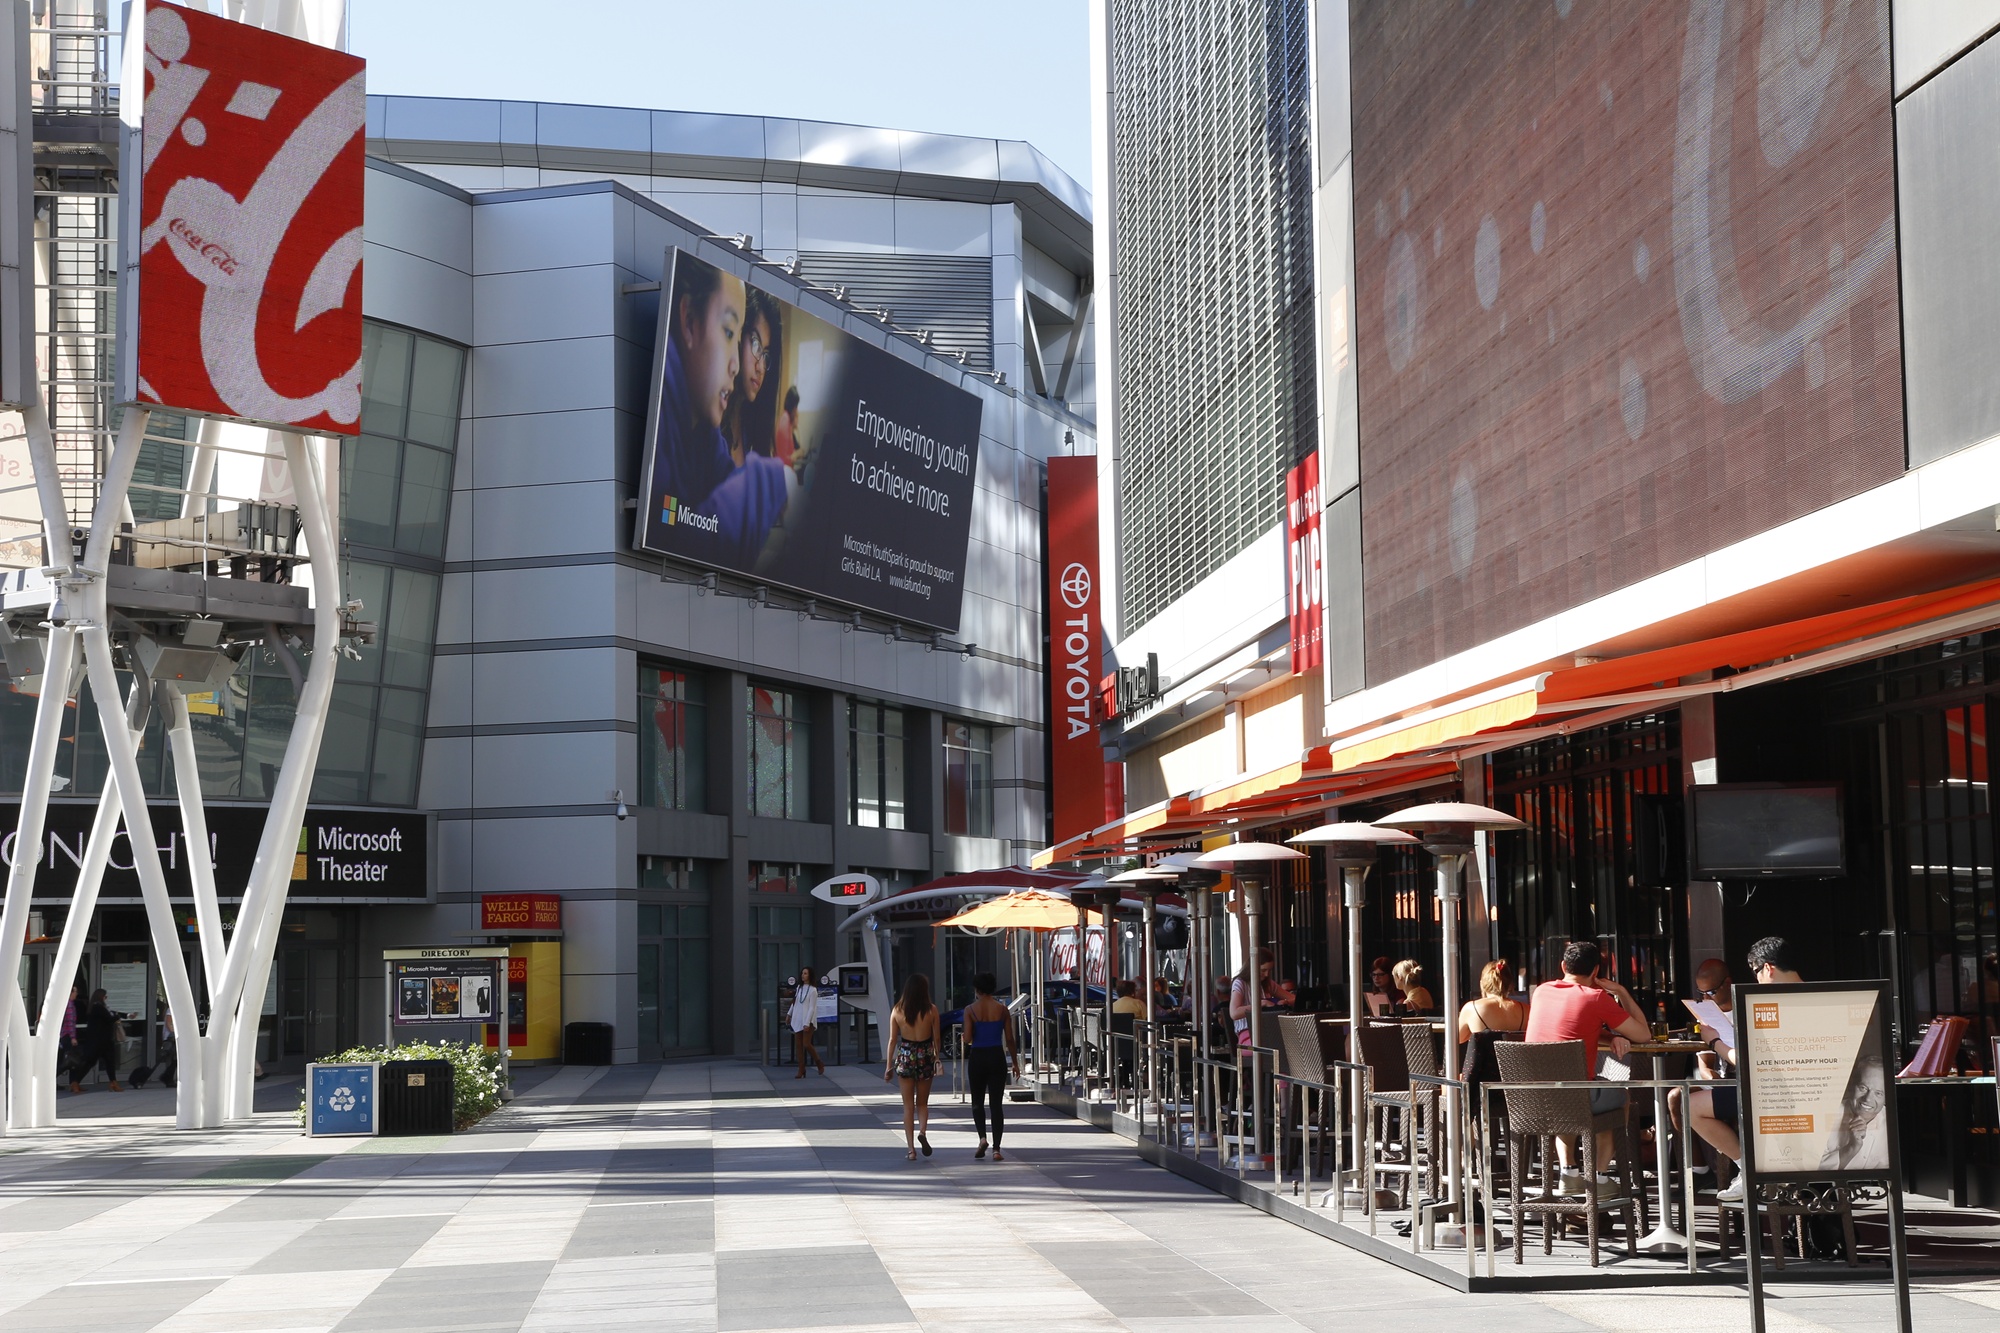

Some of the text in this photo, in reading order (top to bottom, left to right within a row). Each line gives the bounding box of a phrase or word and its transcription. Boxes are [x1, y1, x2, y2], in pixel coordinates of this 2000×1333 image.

[856, 400, 969, 476] Empowering youth
[852, 453, 950, 517] to achieve more.
[678, 504, 718, 533] Microsoft
[1290, 484, 1320, 530] WOLFGA
[844, 534, 954, 584] Microsoft YouthSpark is proud to support
[1291, 528, 1321, 616] PUC
[842, 557, 854, 574] Girls
[856, 561, 870, 578] Build
[889, 574, 931, 600] www.lafund.org
[1065, 614, 1090, 740] TOYOTA
[318, 826, 402, 852] Microsoft
[317, 857, 388, 881] Theater
[843, 882, 863, 895] 1:21
[486, 901, 558, 912] WELLS WELLS
[487, 912, 557, 923] FARGO FARGO
[508, 961, 525, 969] LLS
[1756, 1012, 1778, 1022] PUCK
